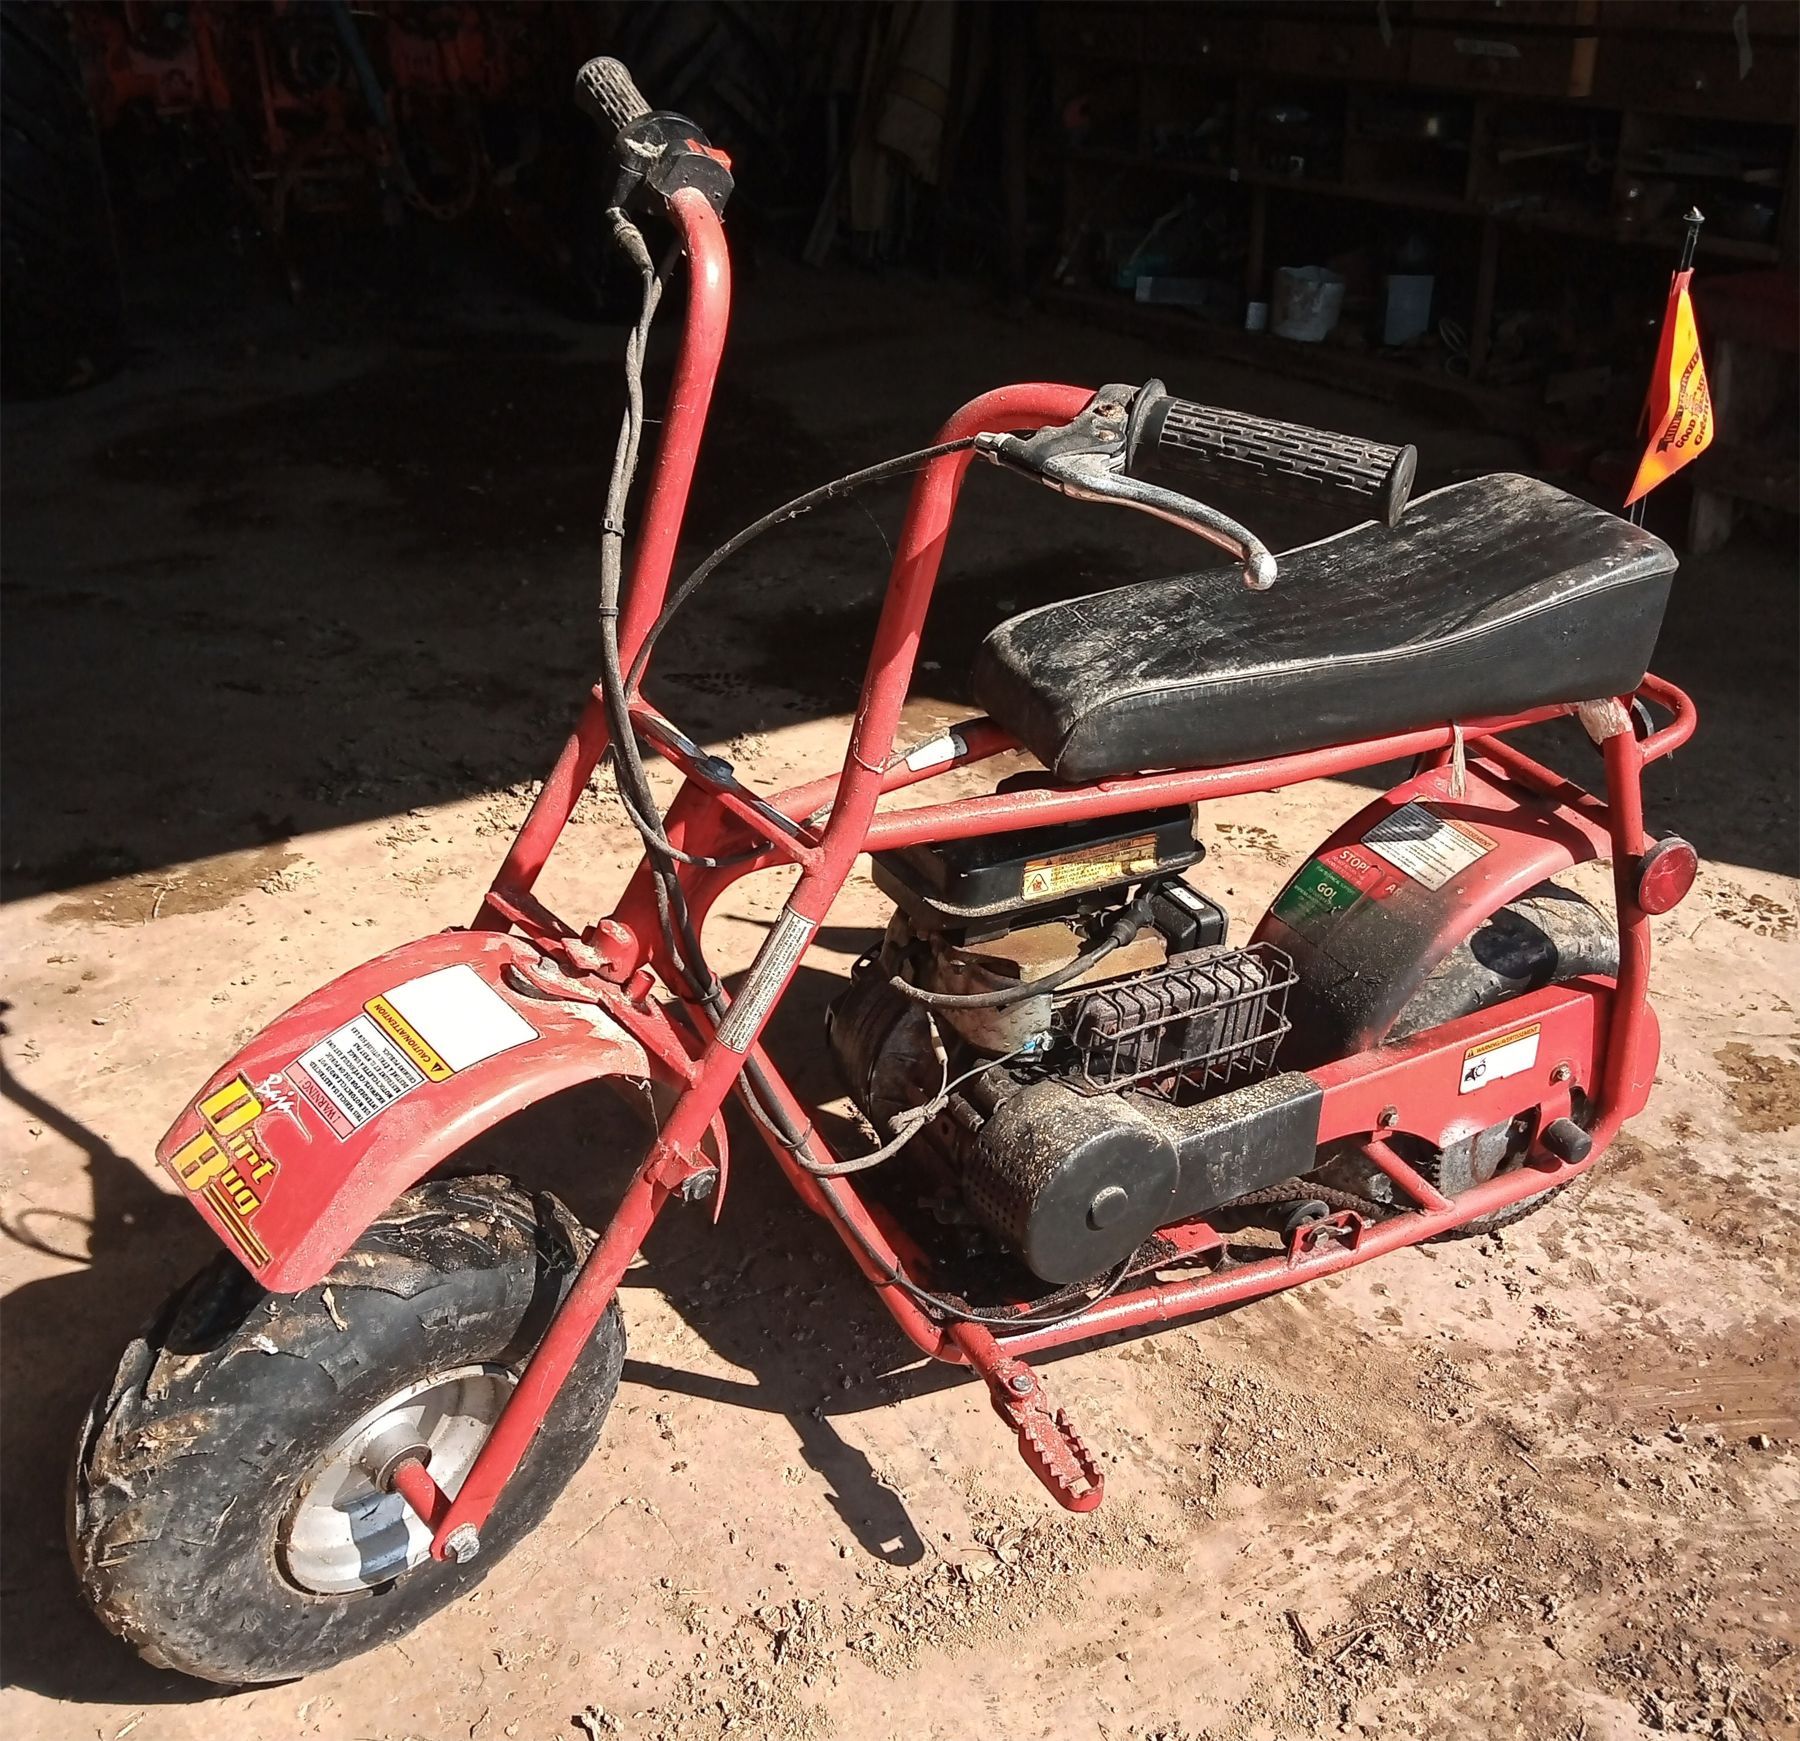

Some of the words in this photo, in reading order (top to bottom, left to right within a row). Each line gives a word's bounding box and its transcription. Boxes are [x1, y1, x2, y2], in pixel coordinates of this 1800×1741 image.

[1676, 419, 1696, 448] GOOD
[1339, 850, 1370, 874] STOP!
[1317, 882, 1337, 900] GO!
[372, 1002, 432, 1063] CAUTION/ATTENTION
[324, 1052, 340, 1067] PUBLIC
[328, 1069, 340, 1080] AND
[342, 1071, 353, 1081] USE
[349, 1079, 360, 1089] FOR
[361, 1065, 393, 1098] MOTOCYCLETTE
[300, 1079, 338, 1120] WARNING
[336, 1078, 364, 1107] MOTORCYCLE
[336, 1092, 355, 1112] VEHICLE
[357, 1087, 378, 1110] INTENDED
[352, 1110, 363, 1121] THIS
[360, 1105, 371, 1115] USE
[199, 1076, 276, 1184] Dirt
[169, 1129, 261, 1216] Bug
